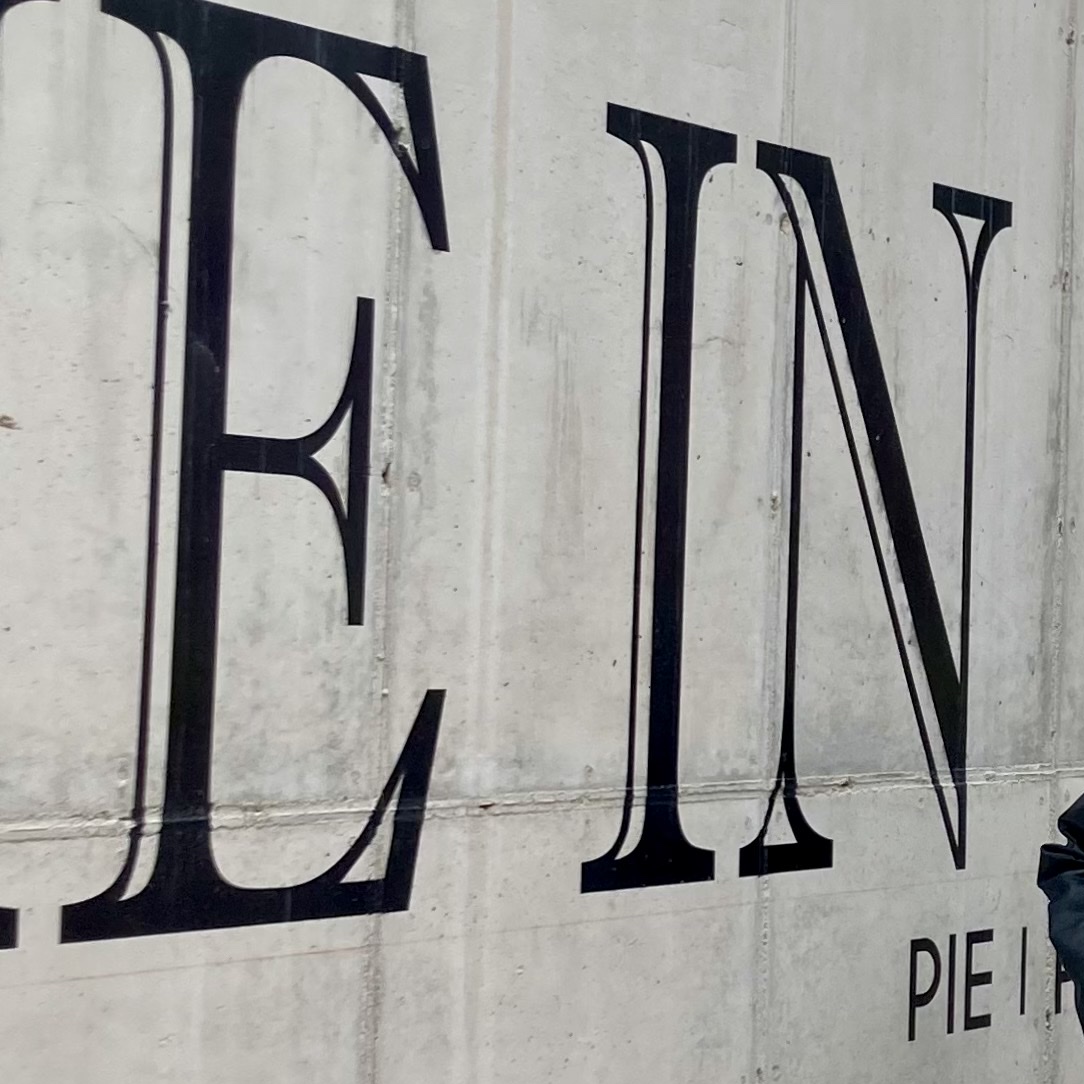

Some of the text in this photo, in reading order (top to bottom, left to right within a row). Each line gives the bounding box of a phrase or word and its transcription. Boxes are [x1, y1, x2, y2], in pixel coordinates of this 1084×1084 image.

[0, 0, 450, 949] E
[581, 101, 1012, 893] IN
[908, 929, 994, 1041] PIE
